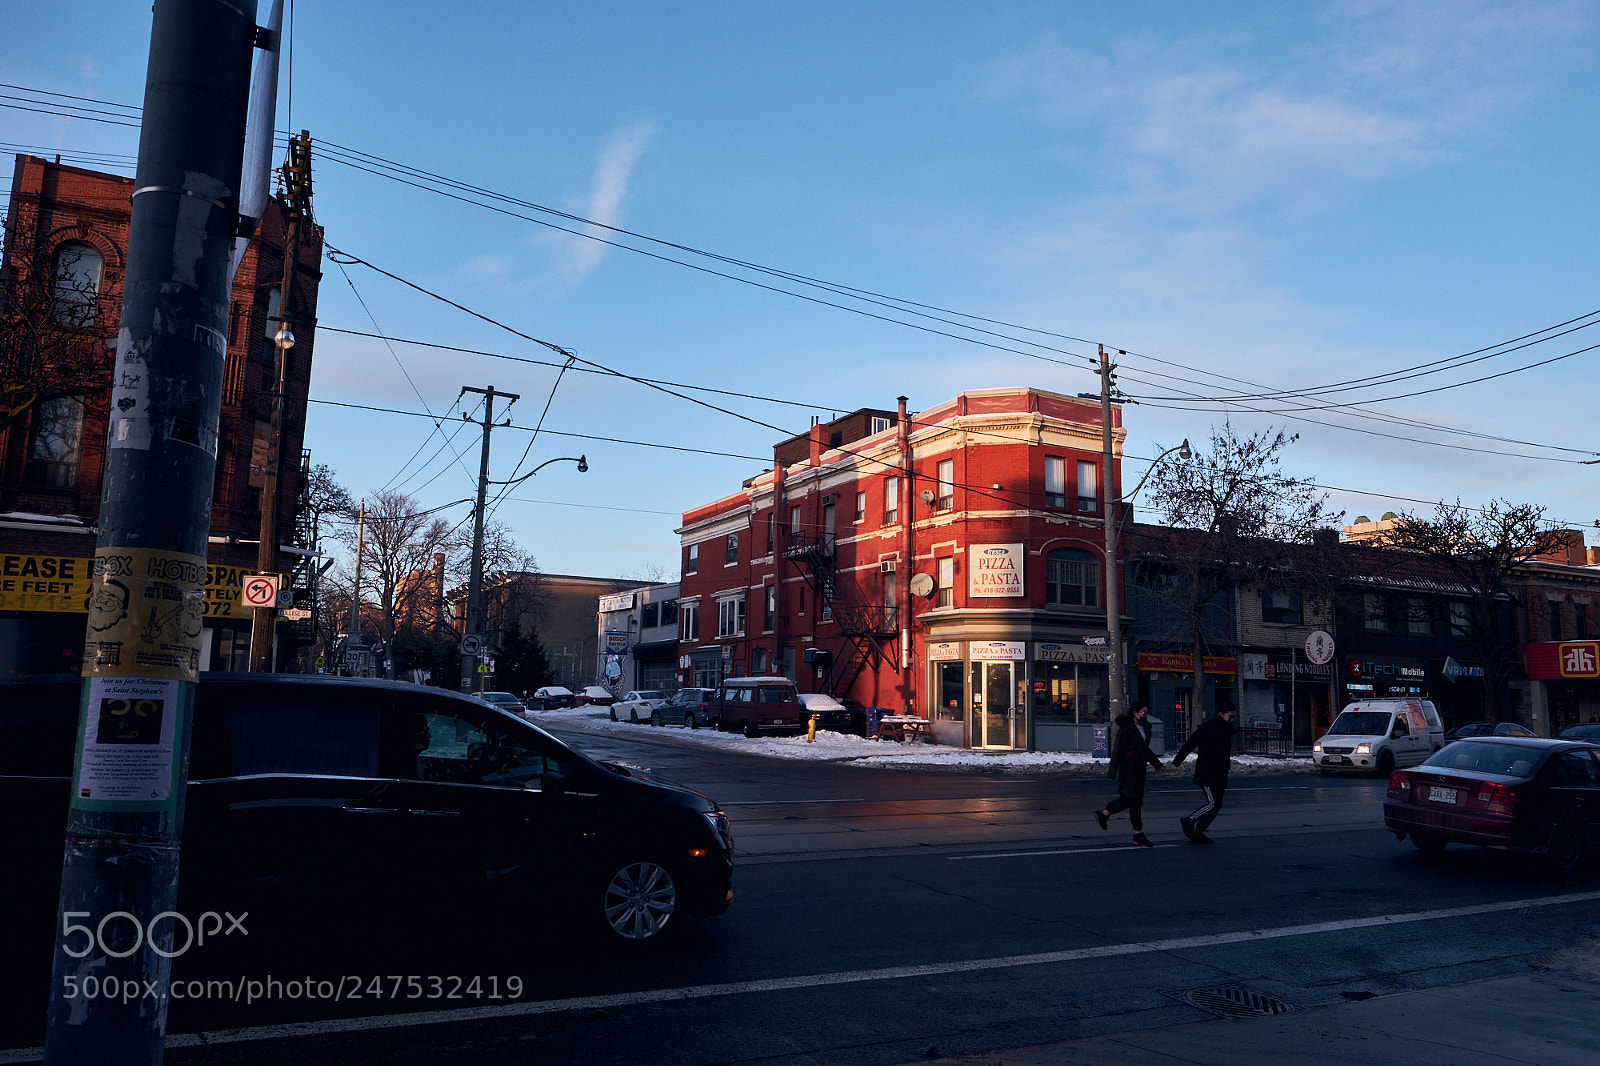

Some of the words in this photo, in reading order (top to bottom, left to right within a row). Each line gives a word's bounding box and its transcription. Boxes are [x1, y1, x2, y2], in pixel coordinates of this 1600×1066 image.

[0, 555, 75, 579] EASE
[979, 557, 1015, 570] PIZZA
[981, 573, 1020, 585] PASTA
[23, 580, 73, 593] FEET
[346, 653, 358, 661] 30
[1041, 650, 1075, 662] PIZZA
[1276, 662, 1304, 674] LANDNG
[1362, 661, 1400, 675] iTech
[1401, 667, 1425, 677] Mobile
[136, 678, 170, 686] Christmas
[130, 687, 163, 695] Stephen's
